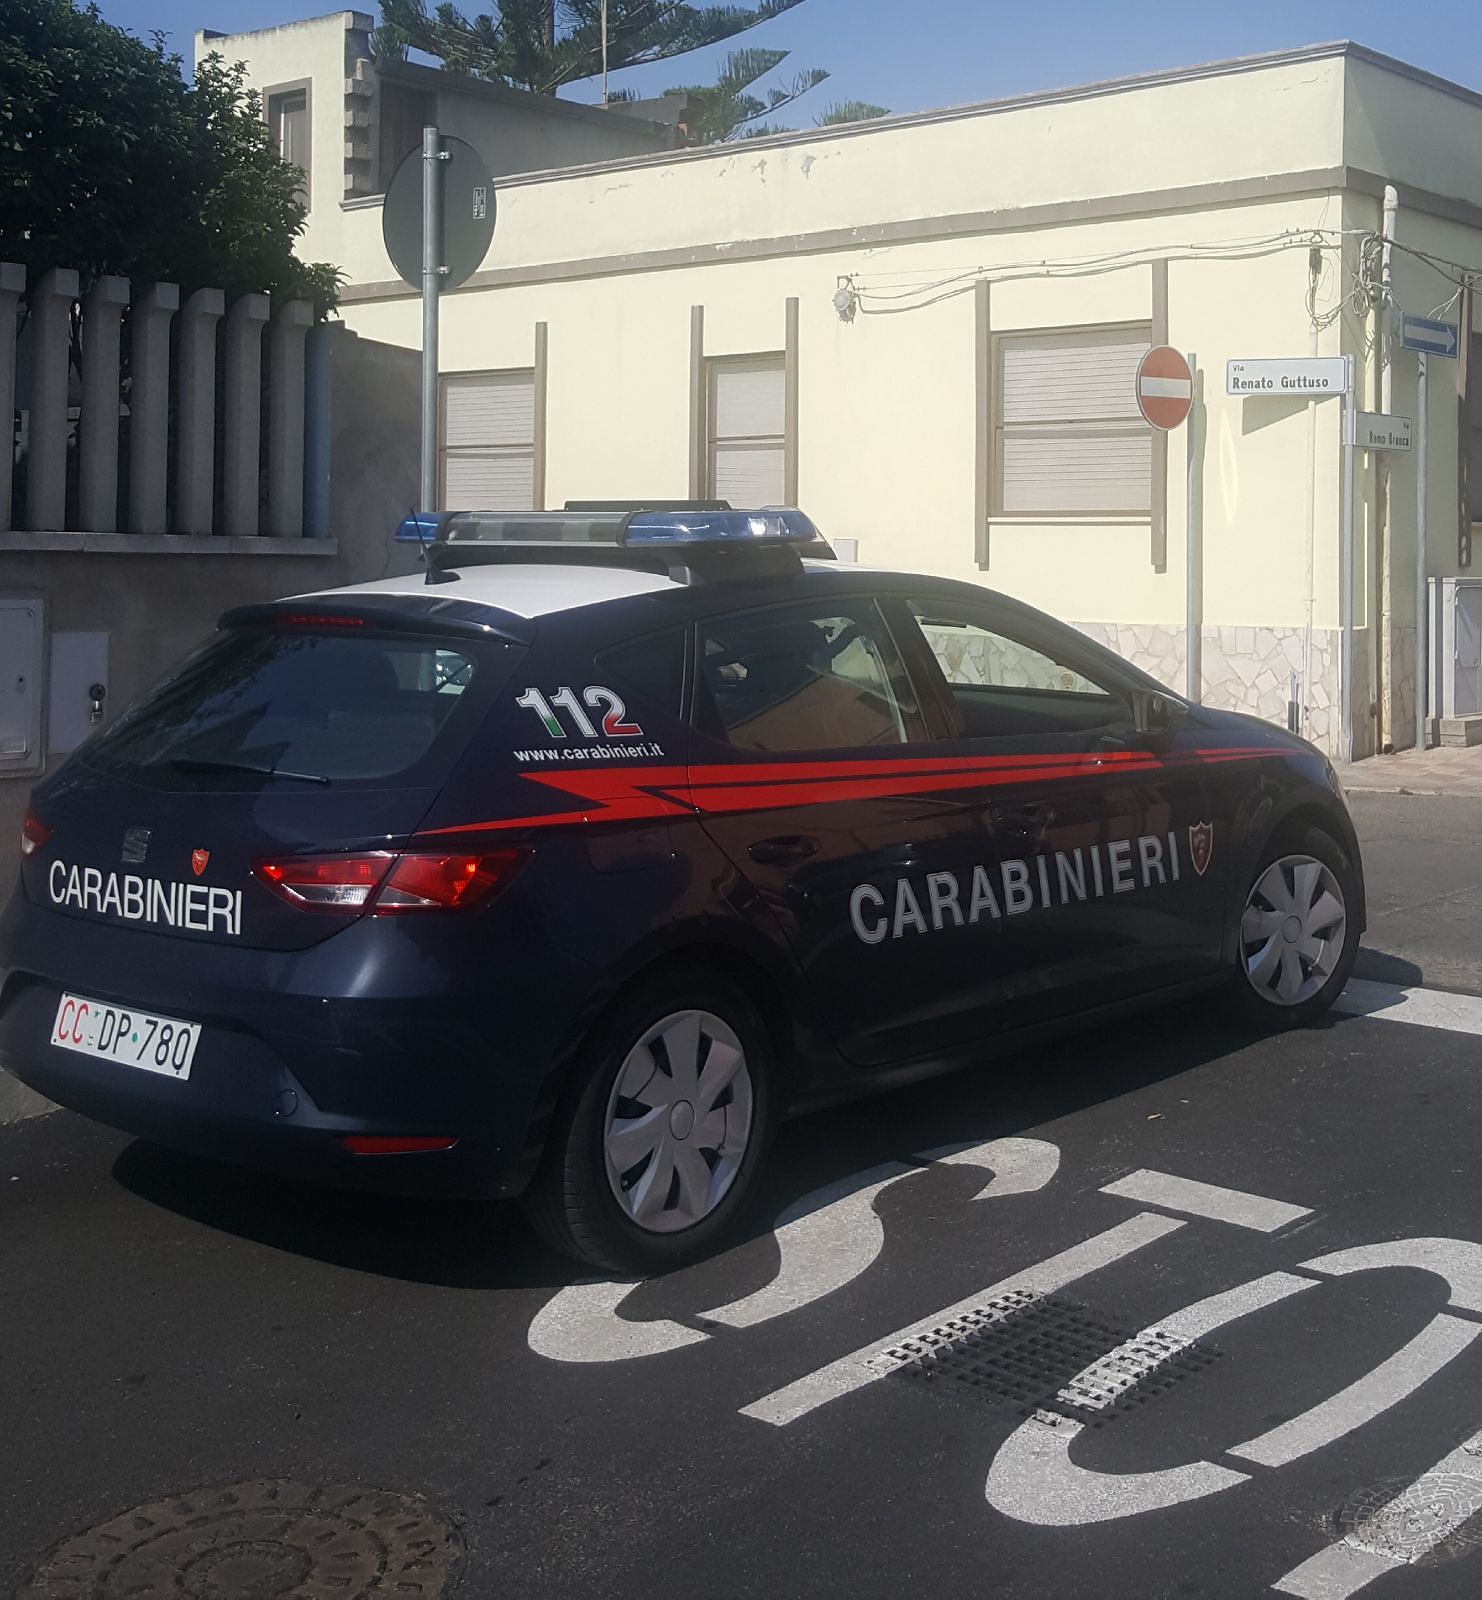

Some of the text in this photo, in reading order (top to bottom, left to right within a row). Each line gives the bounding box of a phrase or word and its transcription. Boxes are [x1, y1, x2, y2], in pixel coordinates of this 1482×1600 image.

[1232, 375, 1329, 389] Renato Guttuso
[515, 685, 644, 738] 112
[513, 742, 665, 762] www.carabinieri.it
[49, 859, 243, 935] CARABINIERI
[849, 831, 1180, 945] CARABINIERI
[57, 1000, 89, 1044] CC
[136, 1018, 192, 1071] 780
